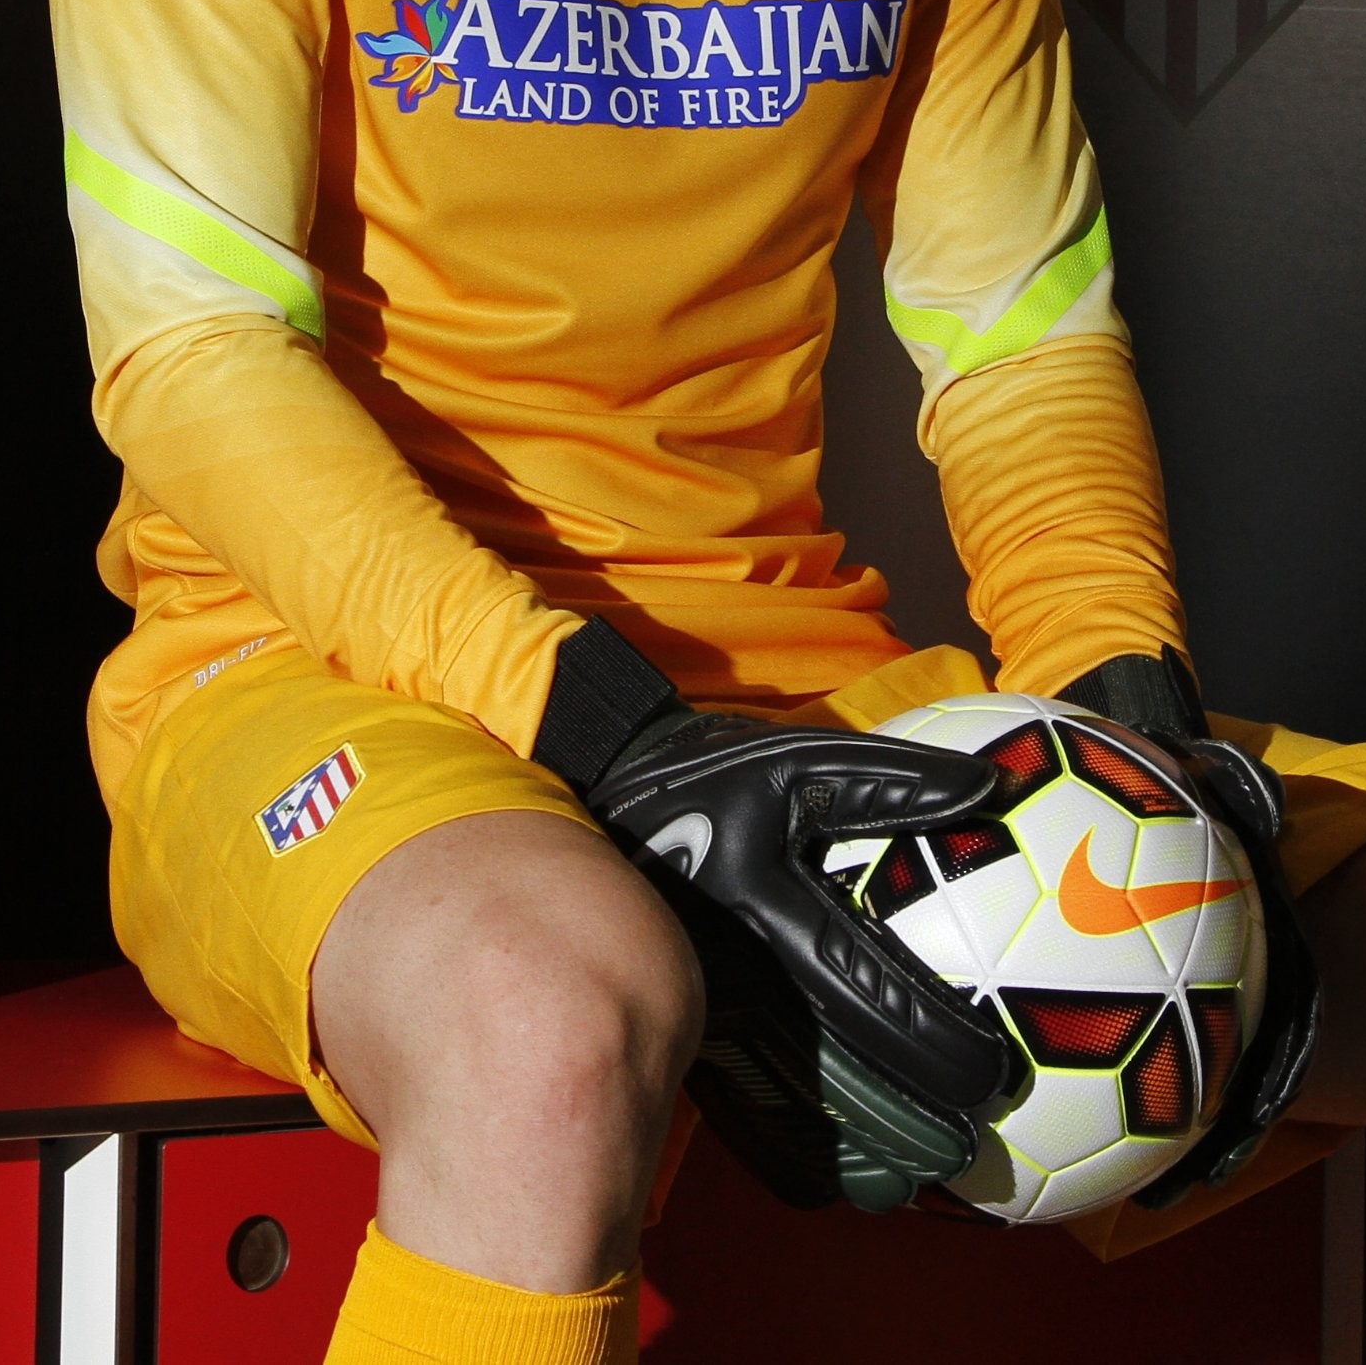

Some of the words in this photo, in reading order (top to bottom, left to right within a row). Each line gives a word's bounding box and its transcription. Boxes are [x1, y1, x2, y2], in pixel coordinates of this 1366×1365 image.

[461, 78, 591, 119] LAND
[609, 89, 658, 124] OF
[682, 87, 781, 124] FIRE
[194, 636, 267, 689] DRI-FIT
